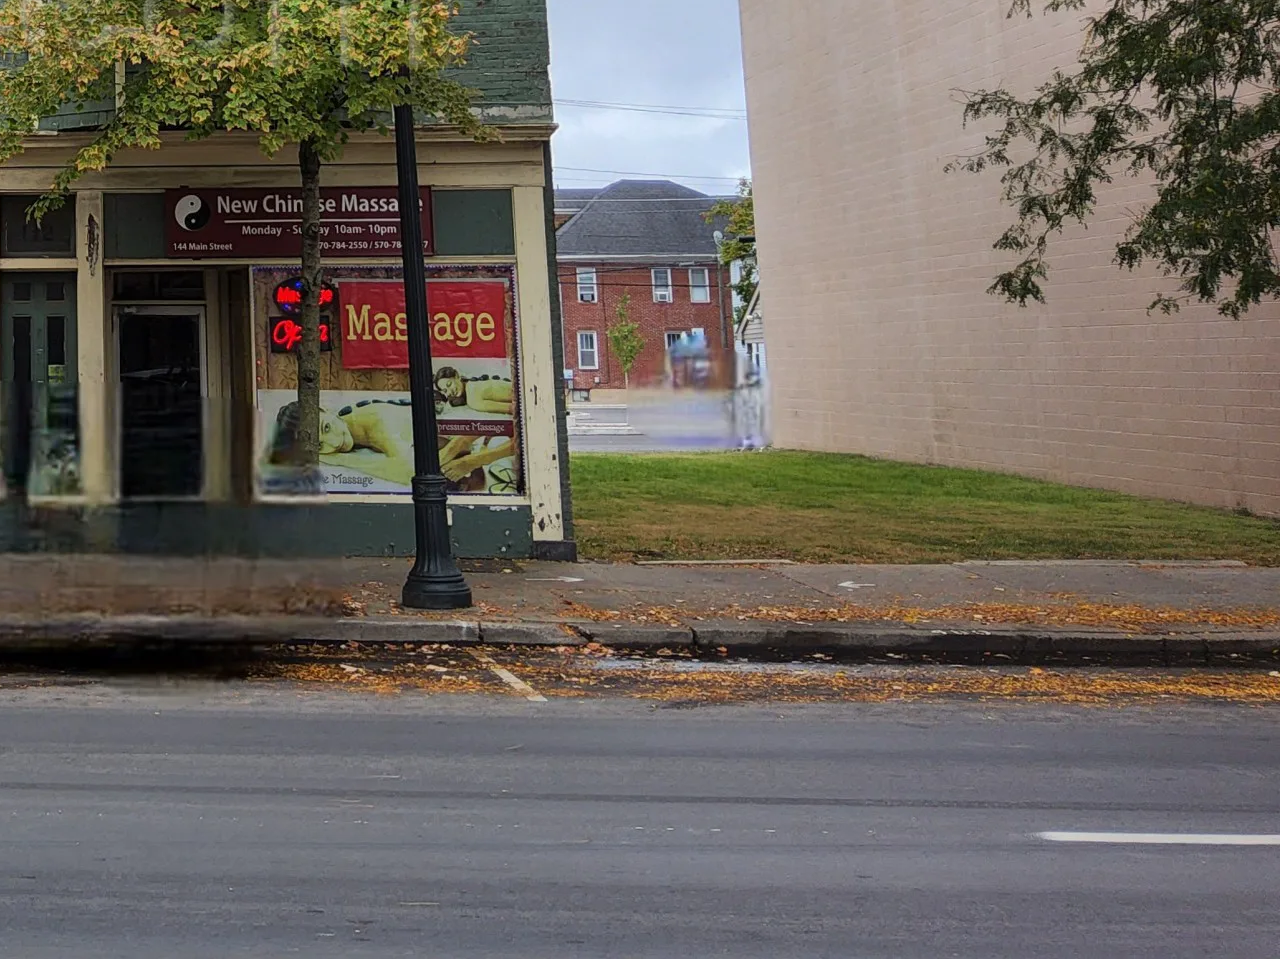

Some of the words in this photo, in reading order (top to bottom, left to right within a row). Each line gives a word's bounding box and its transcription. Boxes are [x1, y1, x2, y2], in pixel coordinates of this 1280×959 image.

[217, 195, 256, 214] New
[263, 194, 335, 214] Chinse
[342, 194, 422, 214] Massae
[241, 224, 282, 237] Monday
[293, 224, 329, 237] Suay
[368, 224, 397, 237] 10pm
[172, 242, 188, 251] 144
[188, 242, 208, 251] Main
[209, 242, 233, 251] Street
[317, 240, 368, 250] 70-784-2550
[345, 303, 496, 348] Masage
[273, 319, 329, 351] Opn
[472, 422, 505, 435] Massage
[331, 474, 374, 487] Massage
